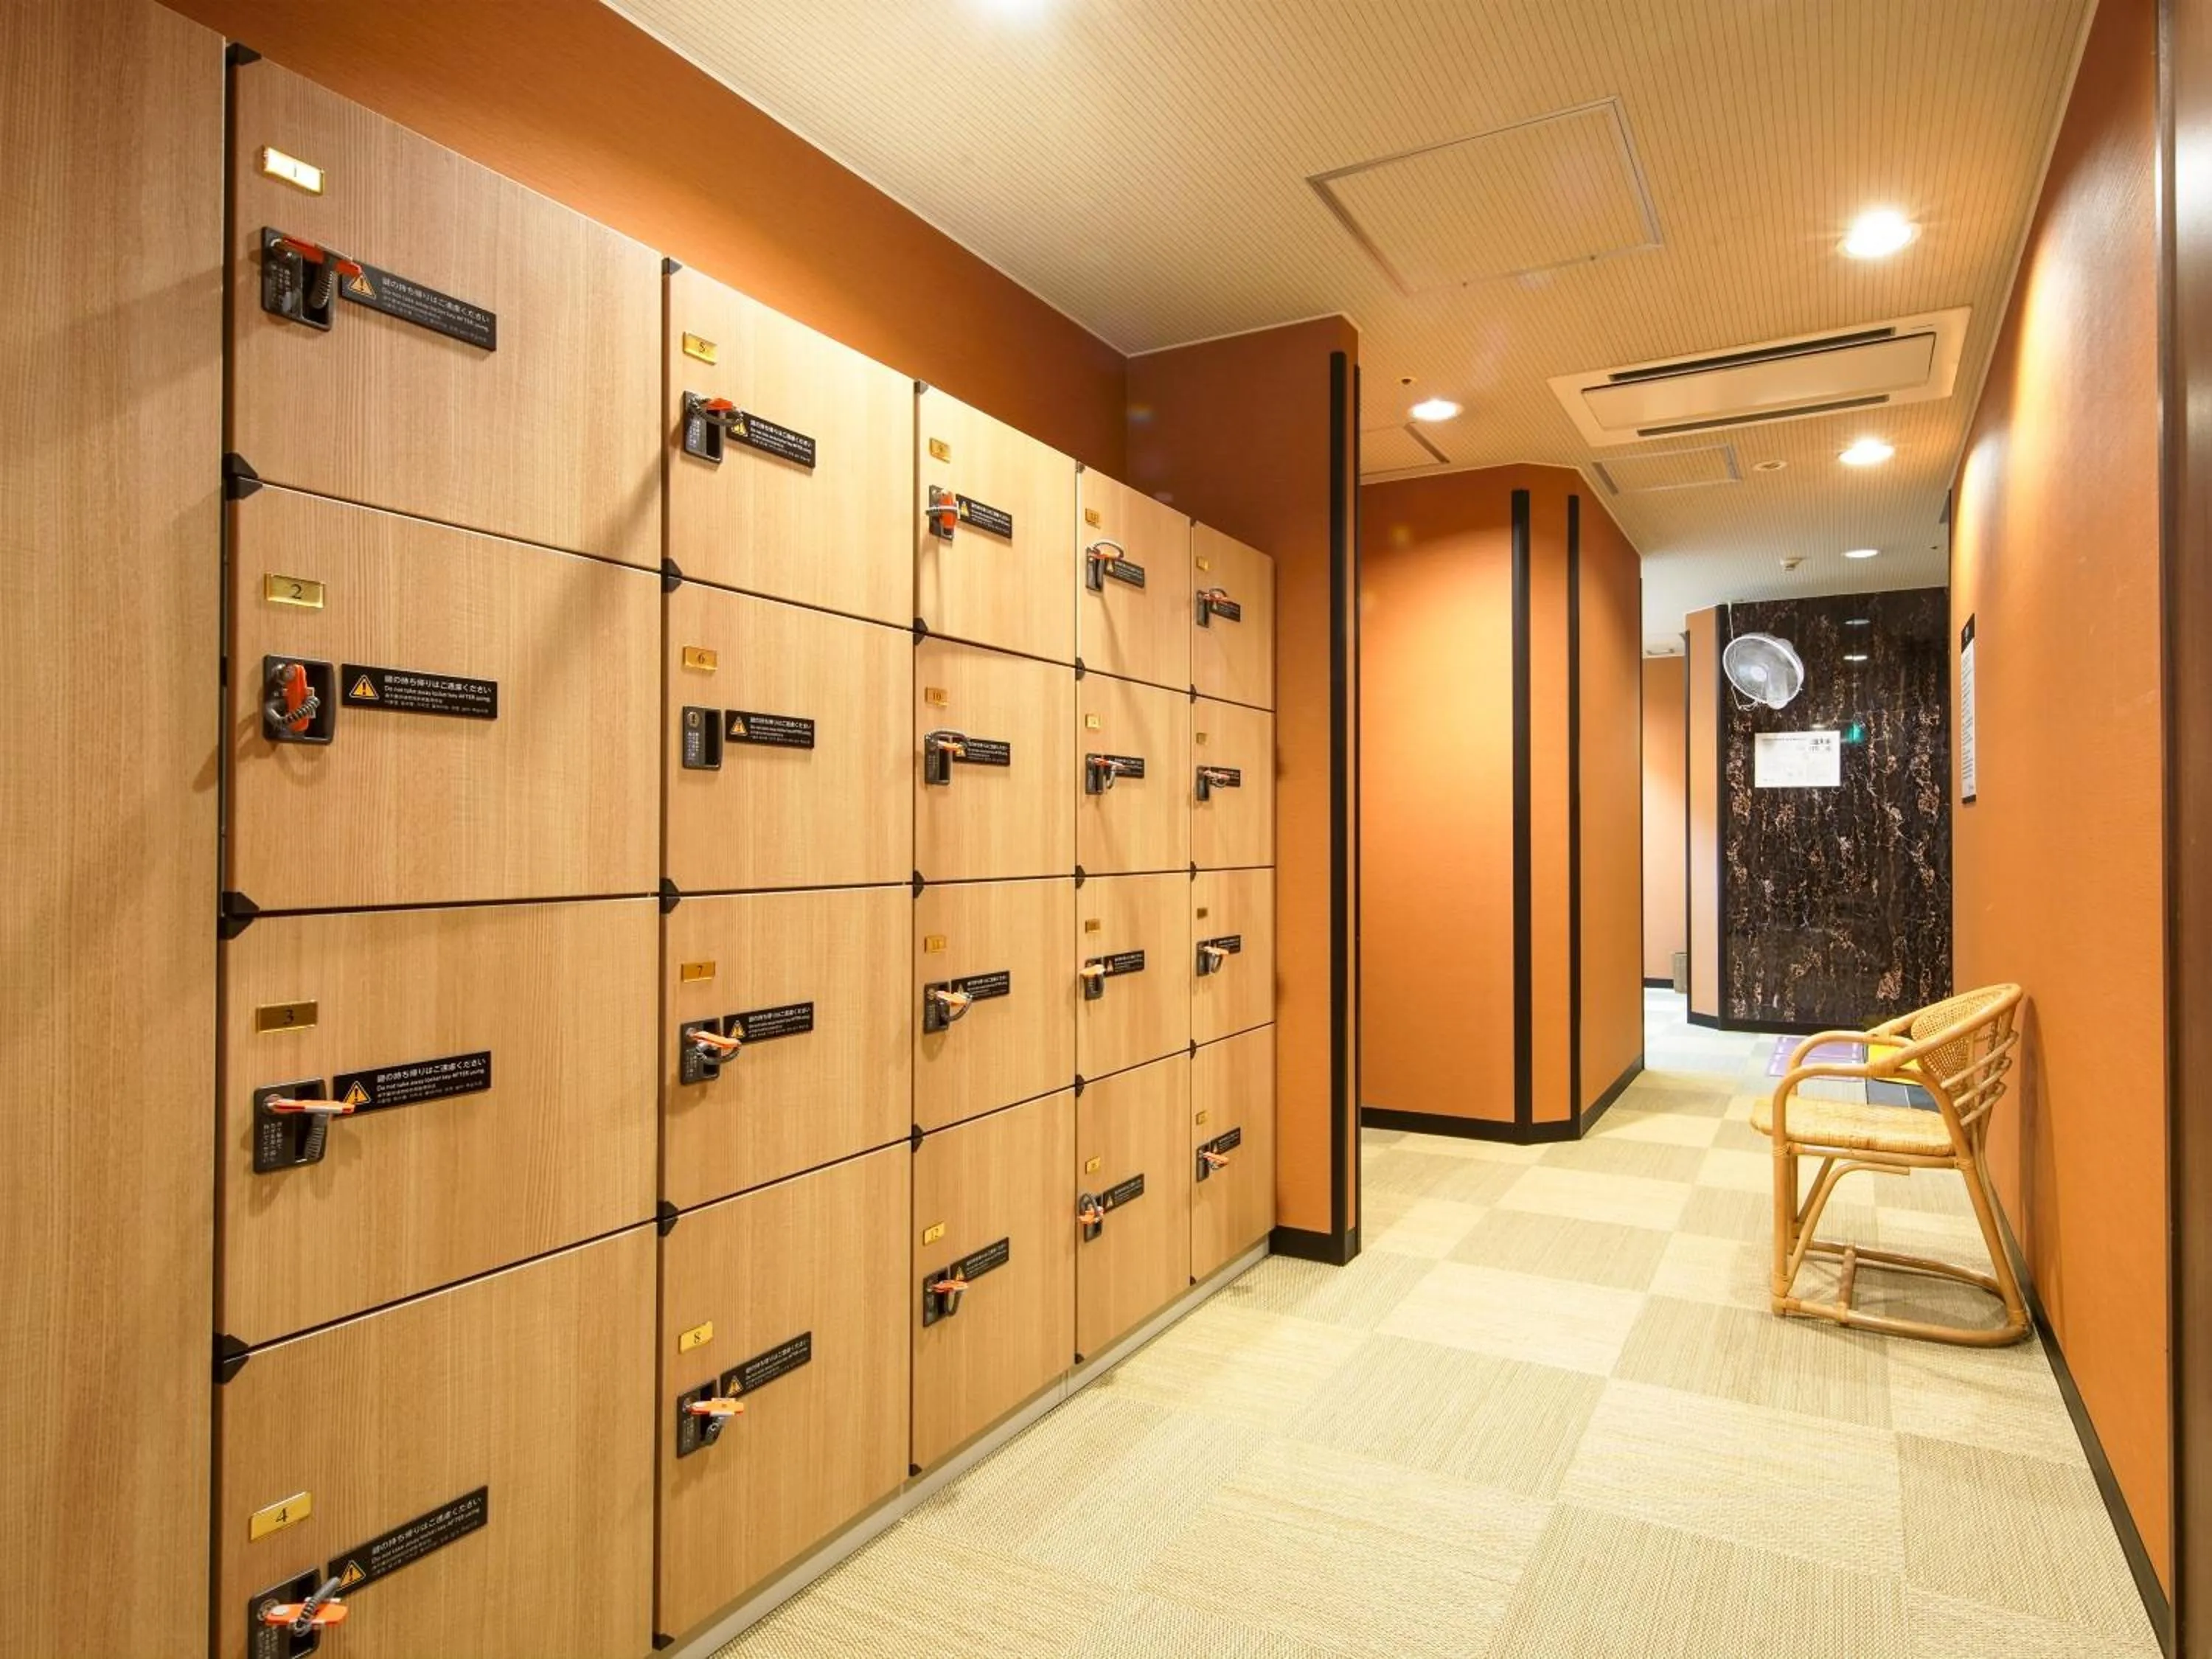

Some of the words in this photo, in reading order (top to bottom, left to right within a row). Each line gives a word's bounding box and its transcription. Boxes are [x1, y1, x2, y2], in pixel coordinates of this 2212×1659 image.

[699, 342, 706, 353] 5
[291, 583, 302, 599] 2
[698, 653, 705, 664] 6
[933, 692, 942, 701] 10
[698, 965, 704, 976] 7
[283, 1009, 294, 1026] 3
[931, 1227, 939, 1239] 12
[694, 1332, 701, 1344] 8
[276, 1507, 288, 1523] 4
